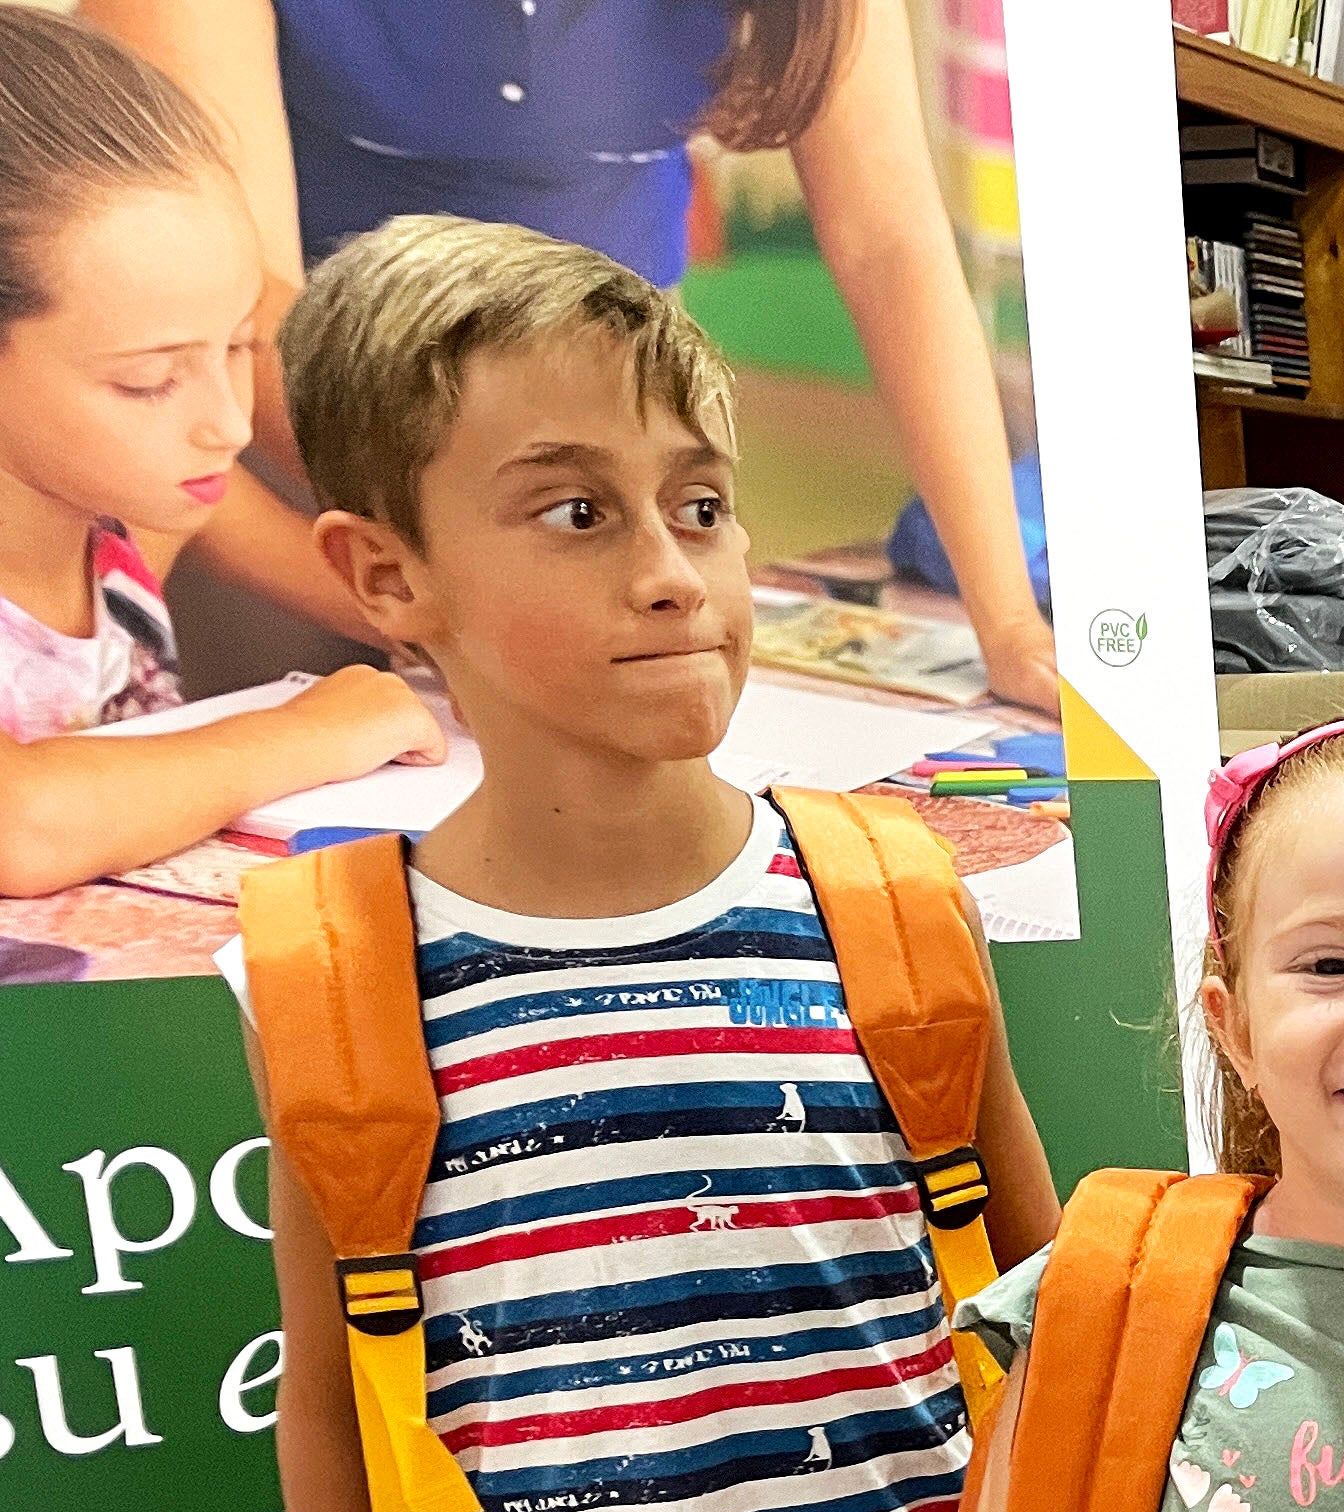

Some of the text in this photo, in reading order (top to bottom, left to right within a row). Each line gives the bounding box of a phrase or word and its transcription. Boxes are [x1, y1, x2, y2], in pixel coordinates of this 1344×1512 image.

[1100, 622, 1130, 637] PVC
[1097, 637, 1136, 653] FREE
[0, 1346, 163, 1459] u
